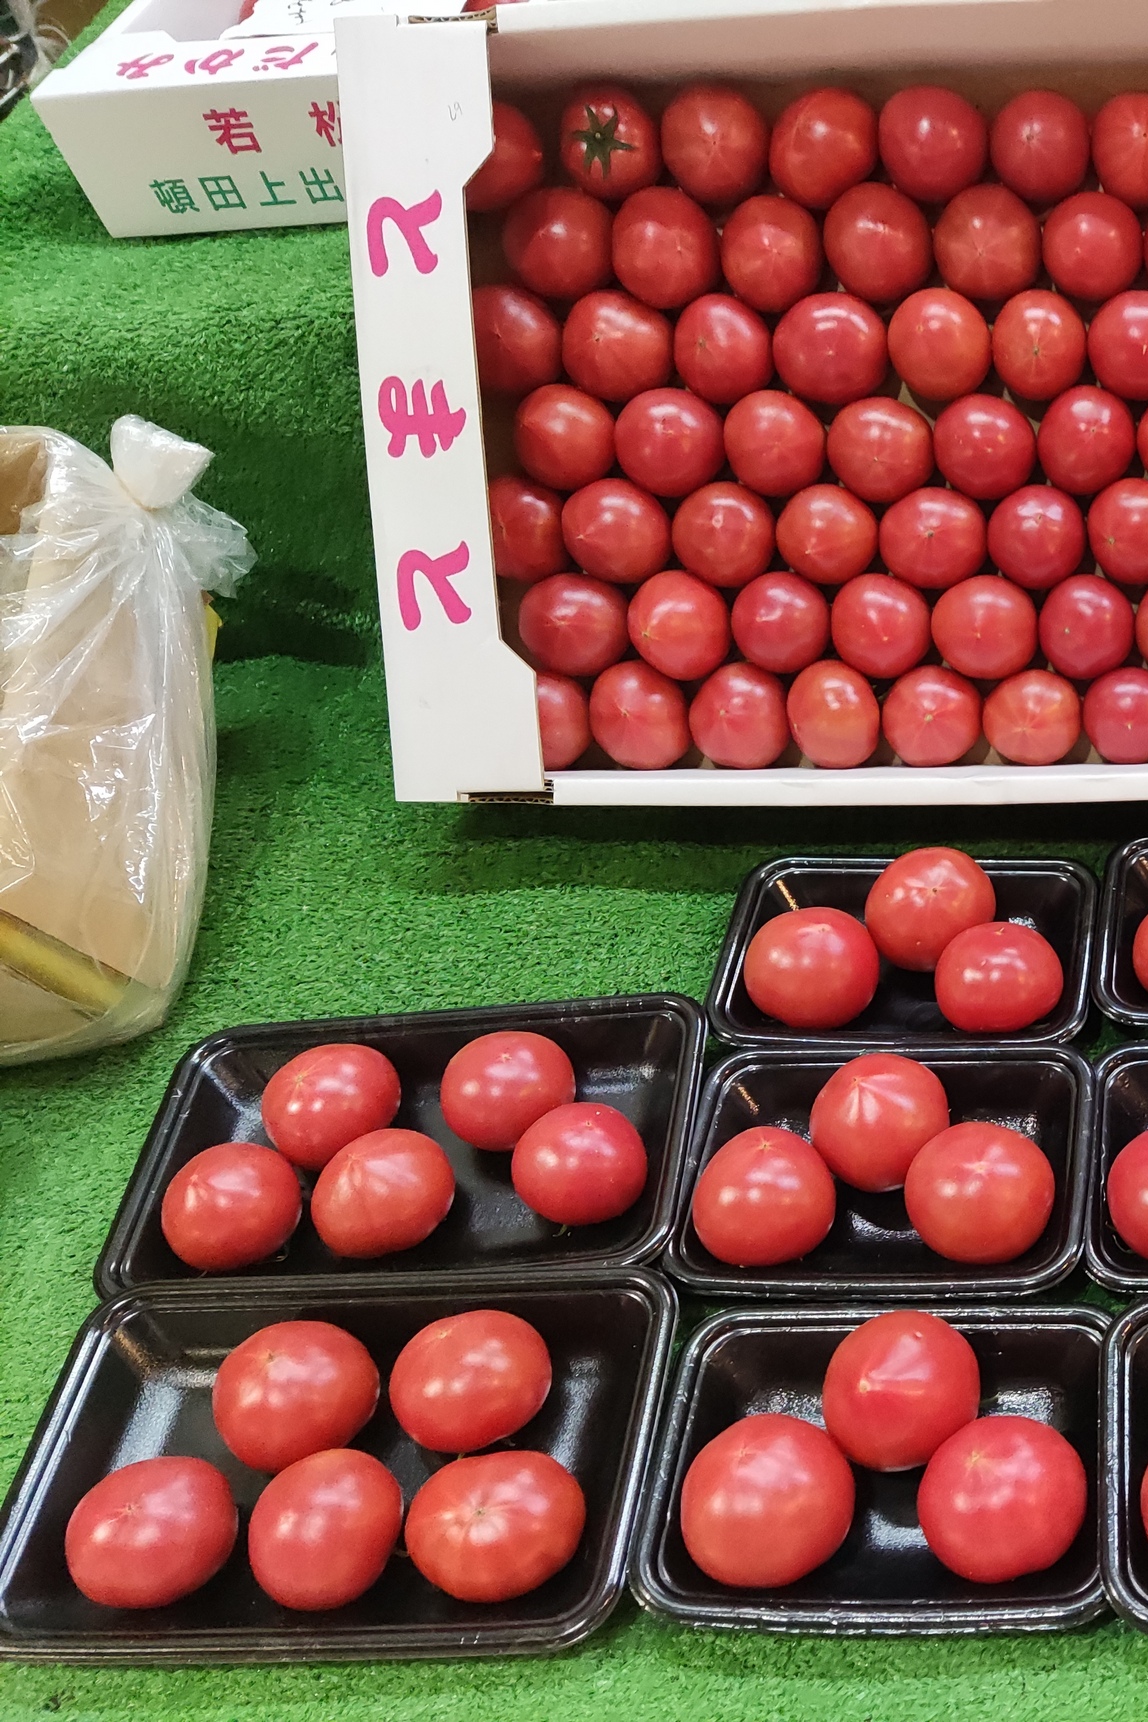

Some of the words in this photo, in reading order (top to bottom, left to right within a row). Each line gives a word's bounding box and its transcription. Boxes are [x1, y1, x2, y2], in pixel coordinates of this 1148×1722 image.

[116, 42, 336, 79] だかみ
[366, 189, 471, 632] とまと
